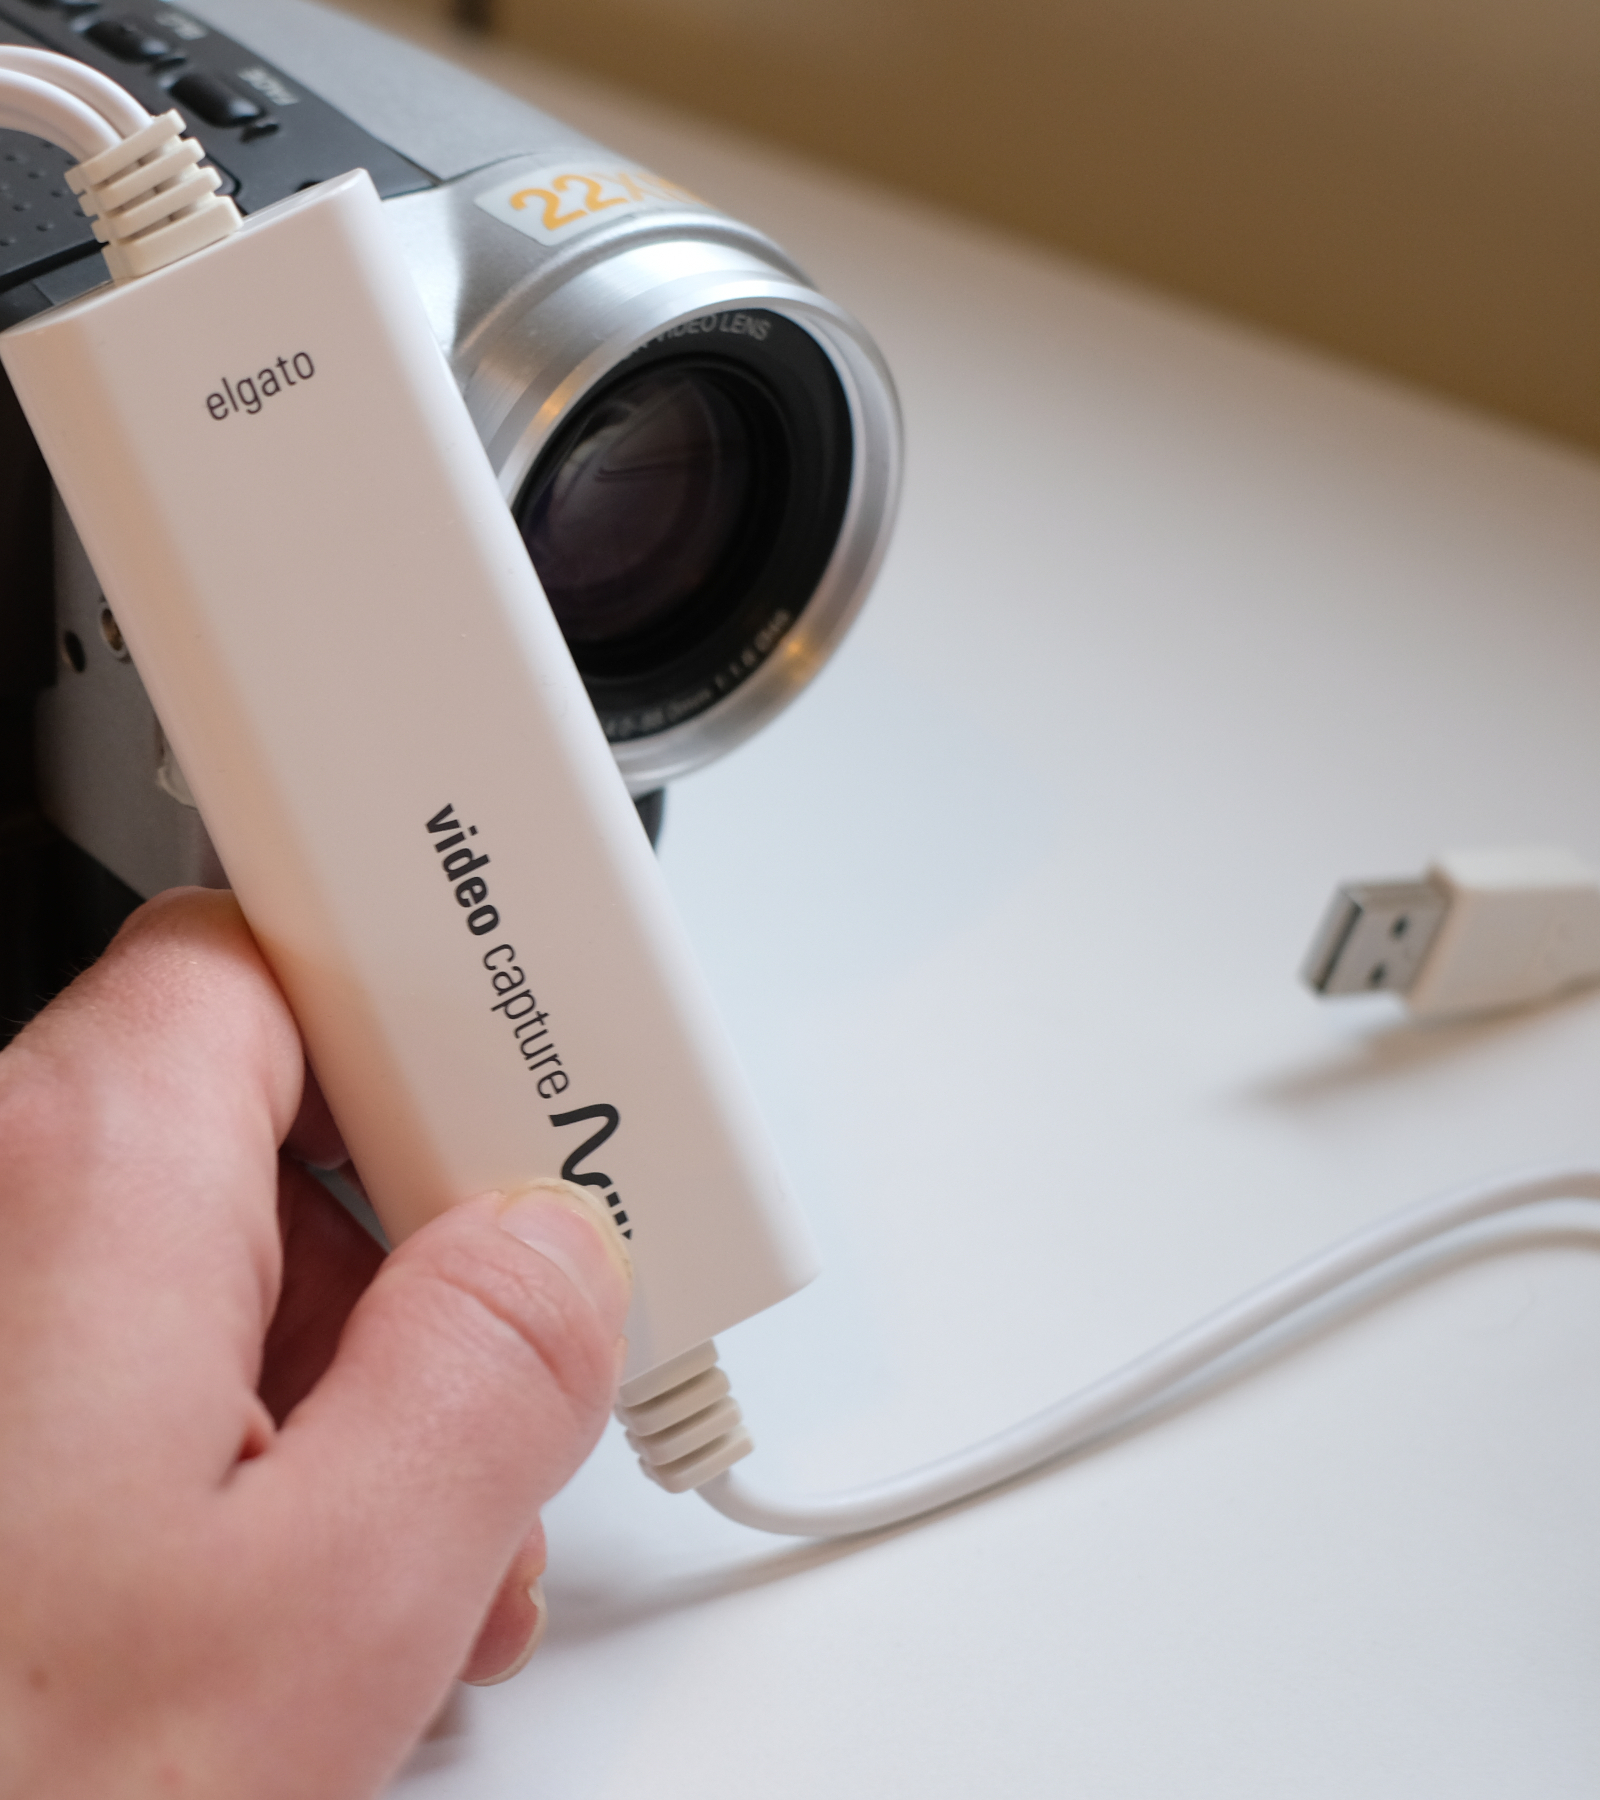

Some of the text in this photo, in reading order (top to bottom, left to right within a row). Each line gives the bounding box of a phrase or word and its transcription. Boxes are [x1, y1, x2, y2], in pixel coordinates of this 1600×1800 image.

[718, 312, 772, 342] LENS
[206, 351, 315, 421] elgato
[425, 802, 570, 1100] video capture
